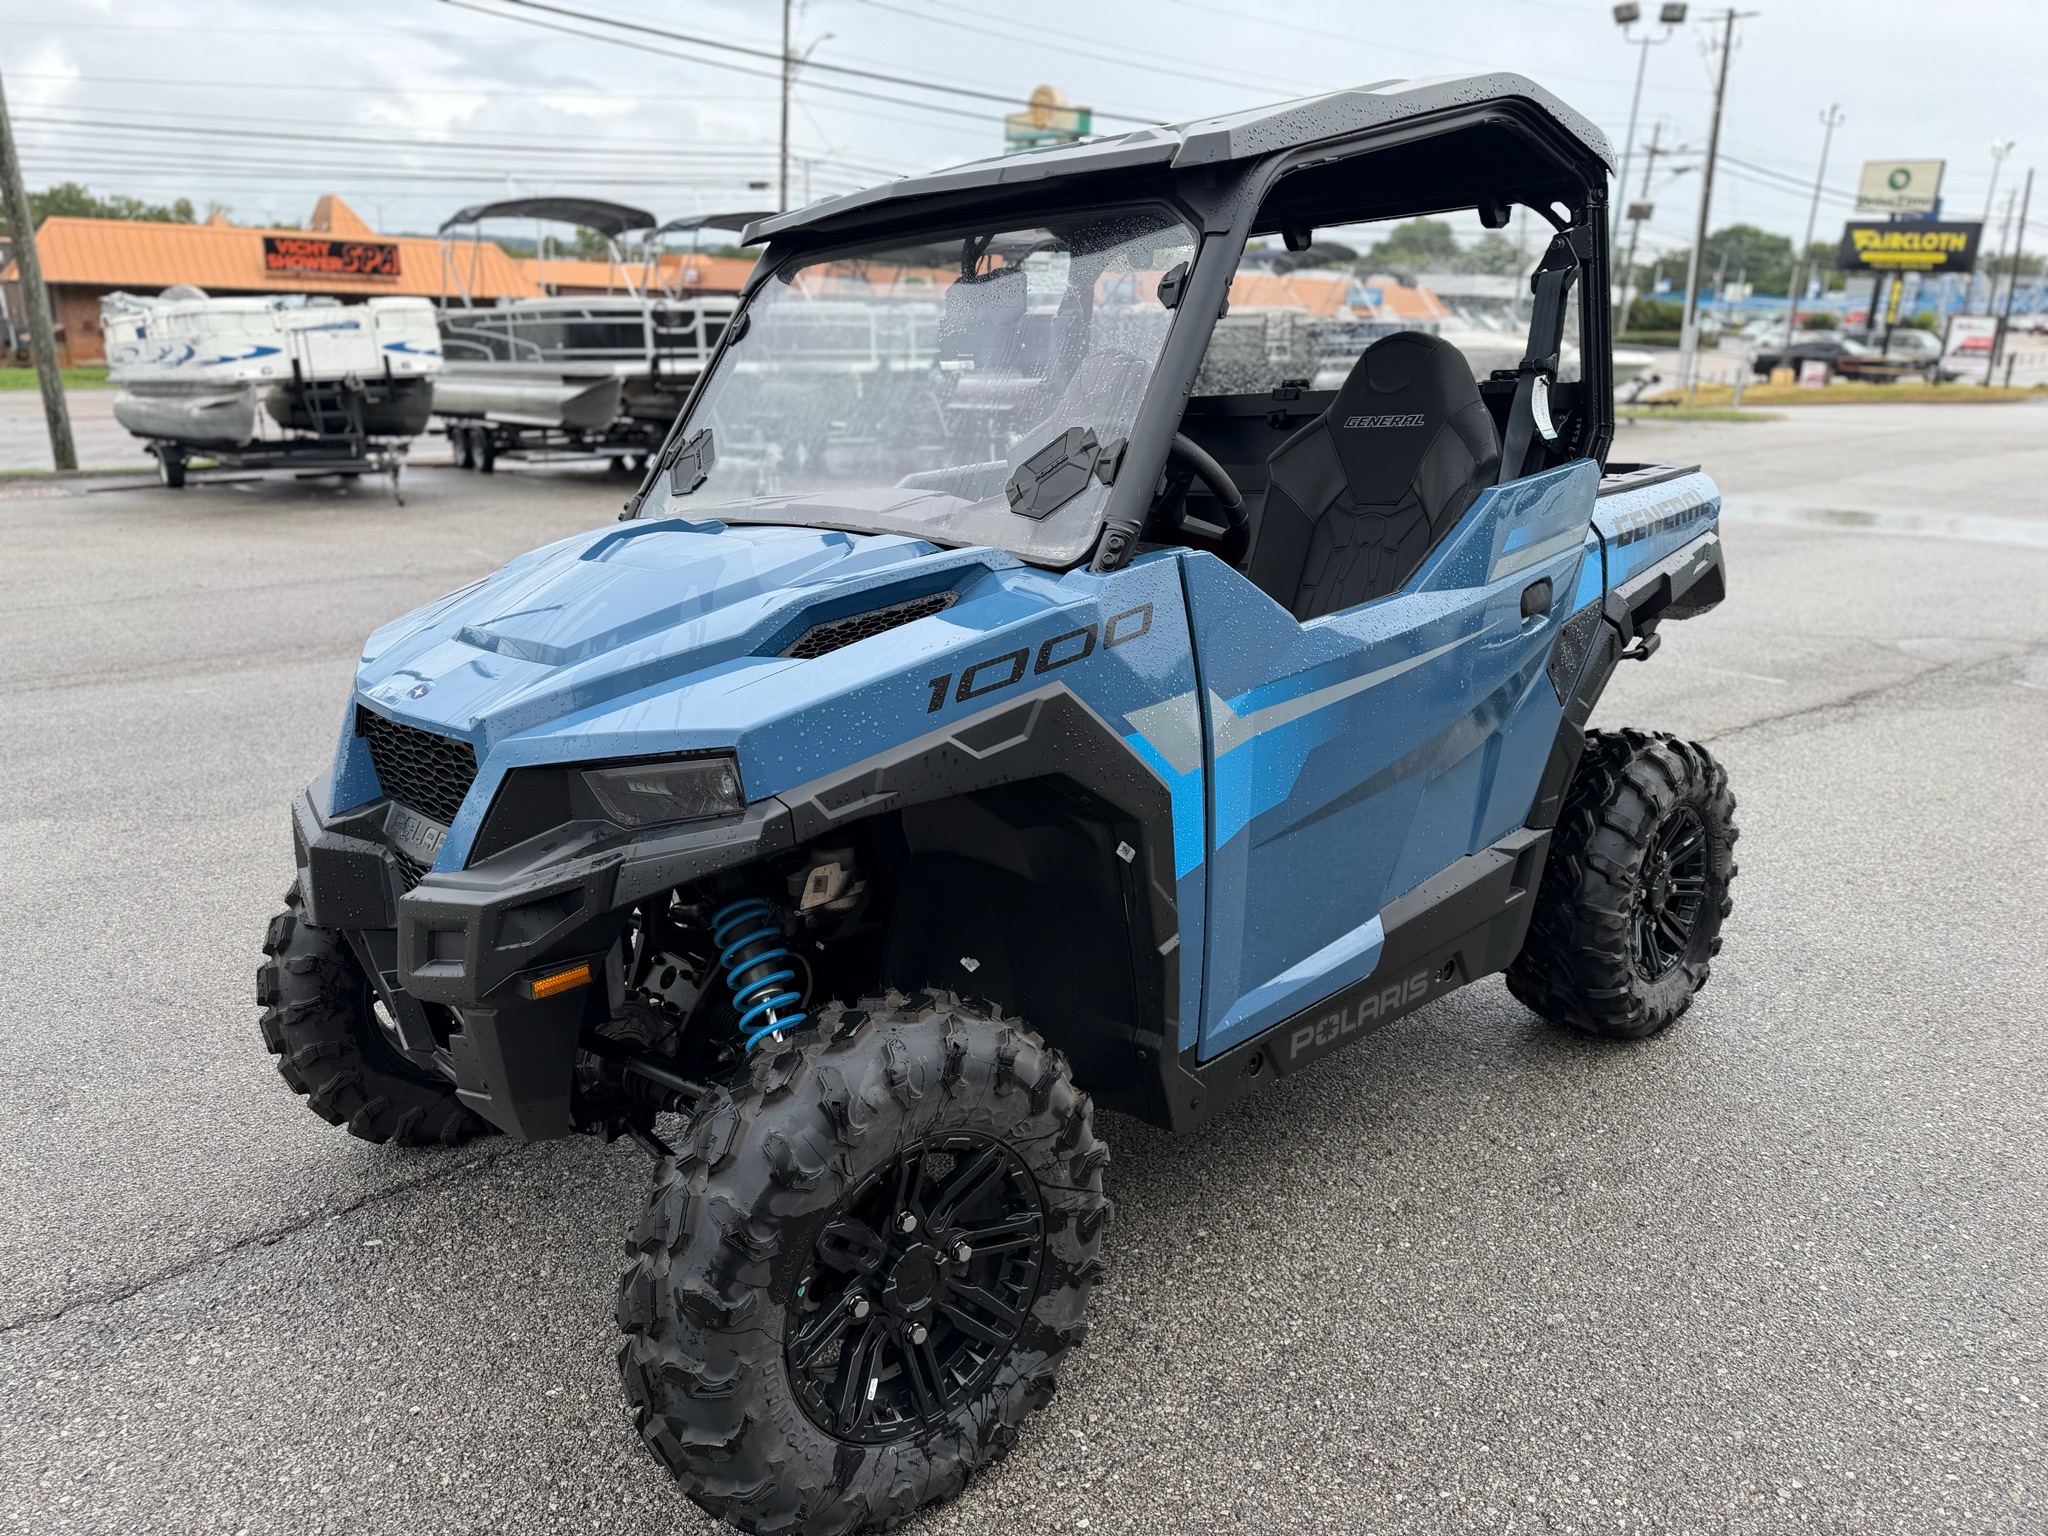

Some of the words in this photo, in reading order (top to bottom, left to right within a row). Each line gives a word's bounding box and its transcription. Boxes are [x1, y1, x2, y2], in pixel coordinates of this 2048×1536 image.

[274, 239, 331, 256] VICHY
[1852, 229, 1967, 251] FAIRCLOTH
[267, 252, 342, 272] SHOWER
[342, 242, 399, 274] SPA
[1343, 413, 1425, 428] GENERAL
[1612, 489, 1710, 549] GENERAL
[926, 601, 1154, 714] 1000
[1290, 968, 1429, 1059] POLARIS
